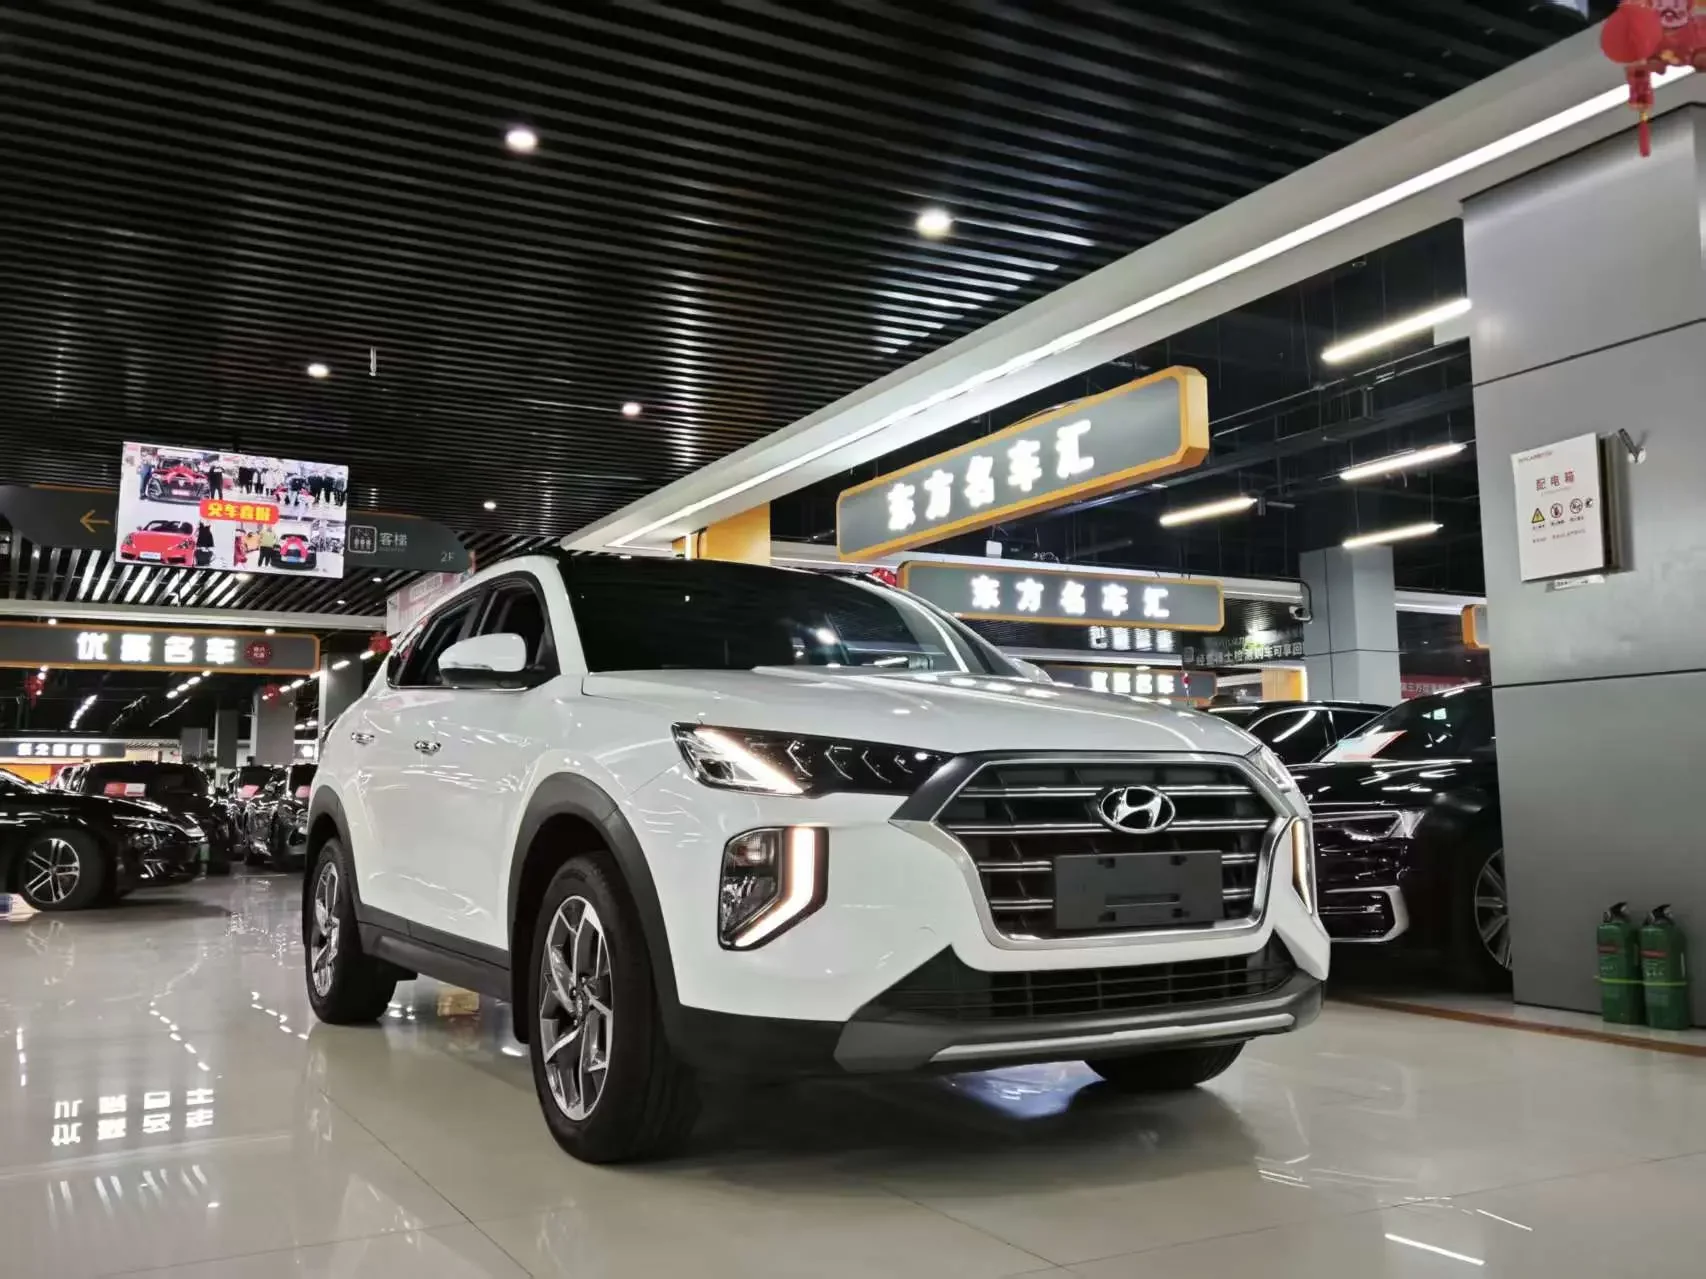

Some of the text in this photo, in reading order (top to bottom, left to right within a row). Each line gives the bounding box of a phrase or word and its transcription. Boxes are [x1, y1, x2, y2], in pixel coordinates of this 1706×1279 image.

[887, 420, 1094, 530] 东方名车汇
[1536, 470, 1576, 491] 配电箱
[380, 532, 407, 546] 客梯
[971, 575, 1169, 617] 东方名车汇
